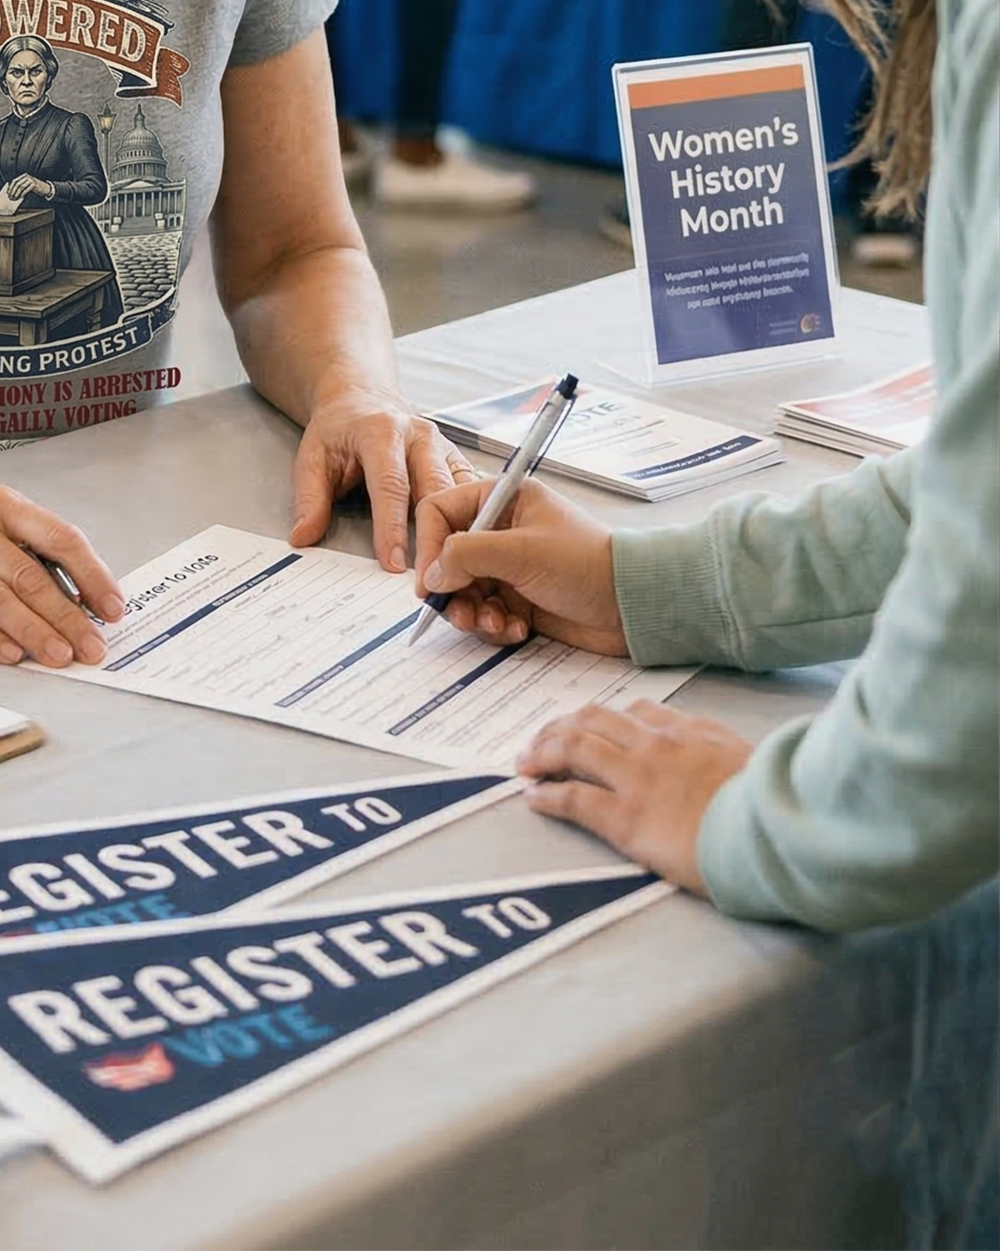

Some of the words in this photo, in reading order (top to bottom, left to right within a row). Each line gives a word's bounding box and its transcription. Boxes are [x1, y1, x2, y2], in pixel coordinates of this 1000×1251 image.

[648, 116, 799, 161] Women's
[670, 162, 785, 199] History
[680, 197, 784, 238] Month
[39, 328, 138, 371] PROTEST
[53, 380, 73, 402] IS
[79, 367, 182, 400] ARRESTED
[63, 400, 137, 428] VOTING
[321, 796, 402, 833] TO
[7, 910, 480, 1054] REGISTER
[461, 896, 552, 939] TO
[160, 1003, 336, 1068] VOTE
